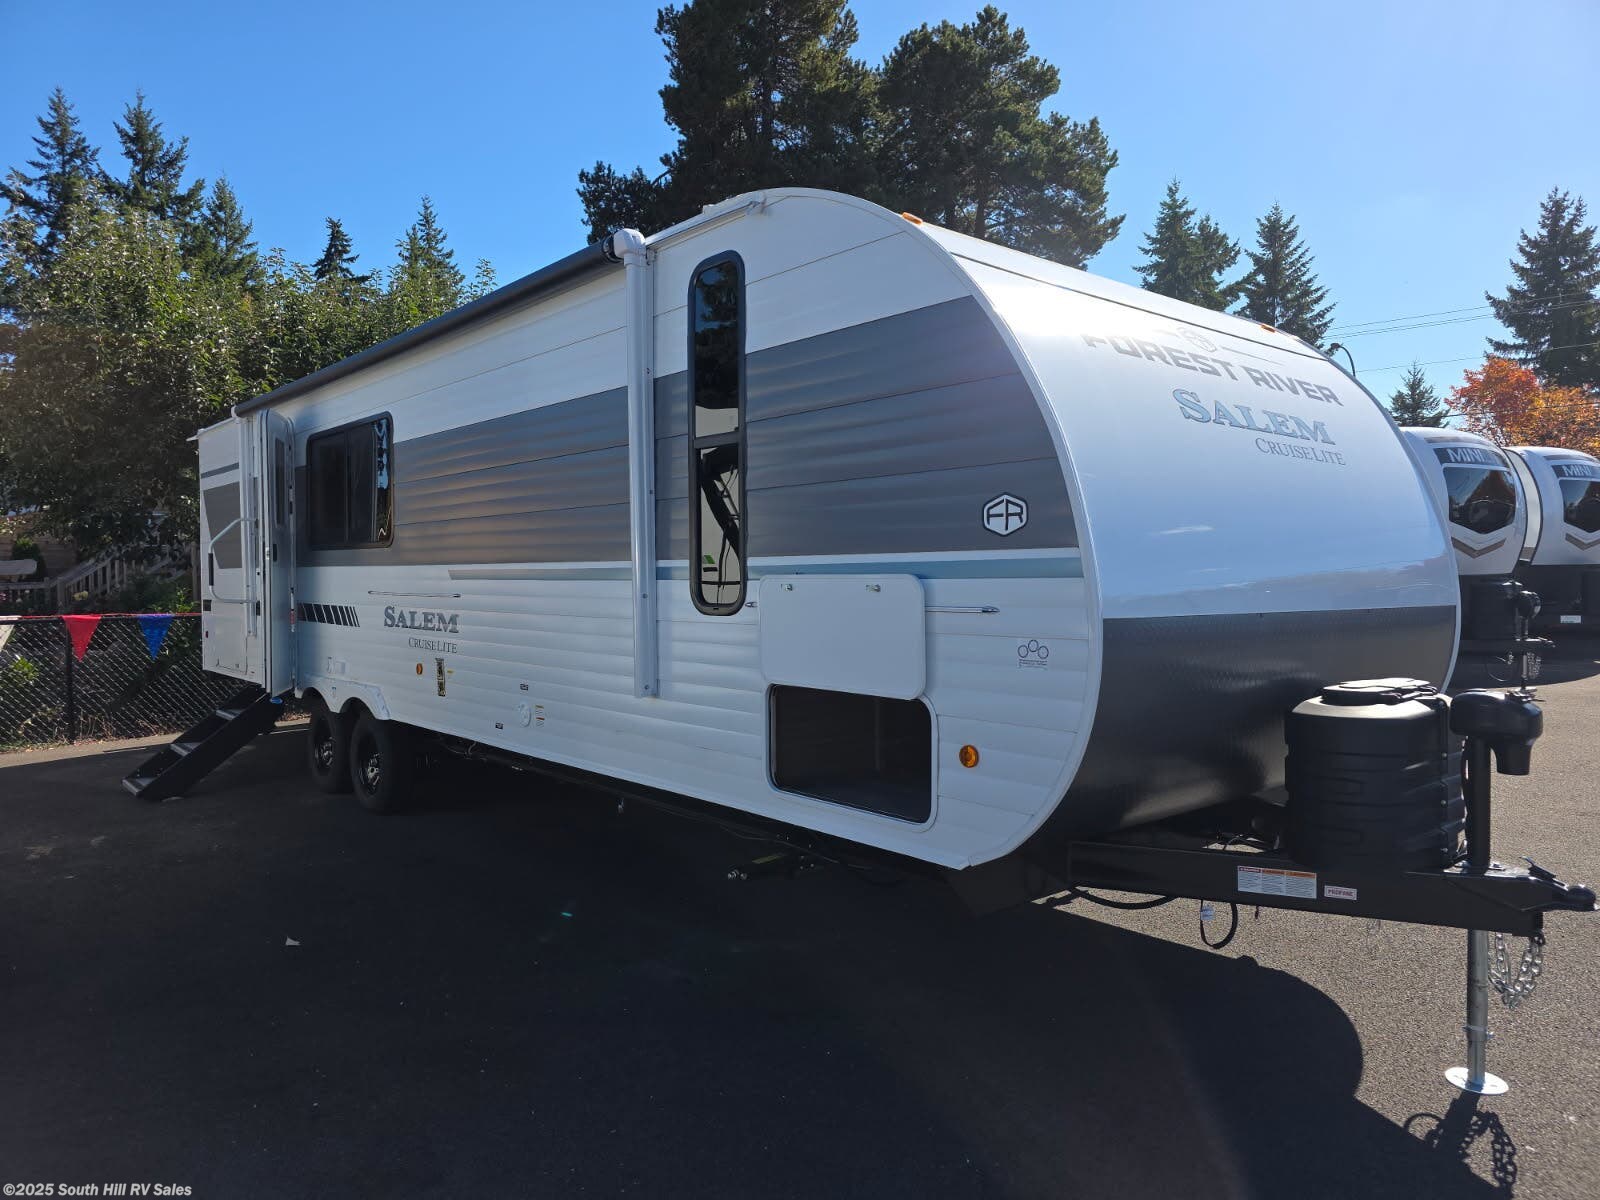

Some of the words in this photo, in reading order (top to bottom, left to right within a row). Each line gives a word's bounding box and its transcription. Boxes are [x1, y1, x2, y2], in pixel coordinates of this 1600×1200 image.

[1240, 366, 1344, 407] RIVER
[1172, 388, 1337, 446] SALEM
[1446, 447, 1485, 463] MINI
[1561, 464, 1593, 477] MINI
[383, 605, 460, 634] SALEM
